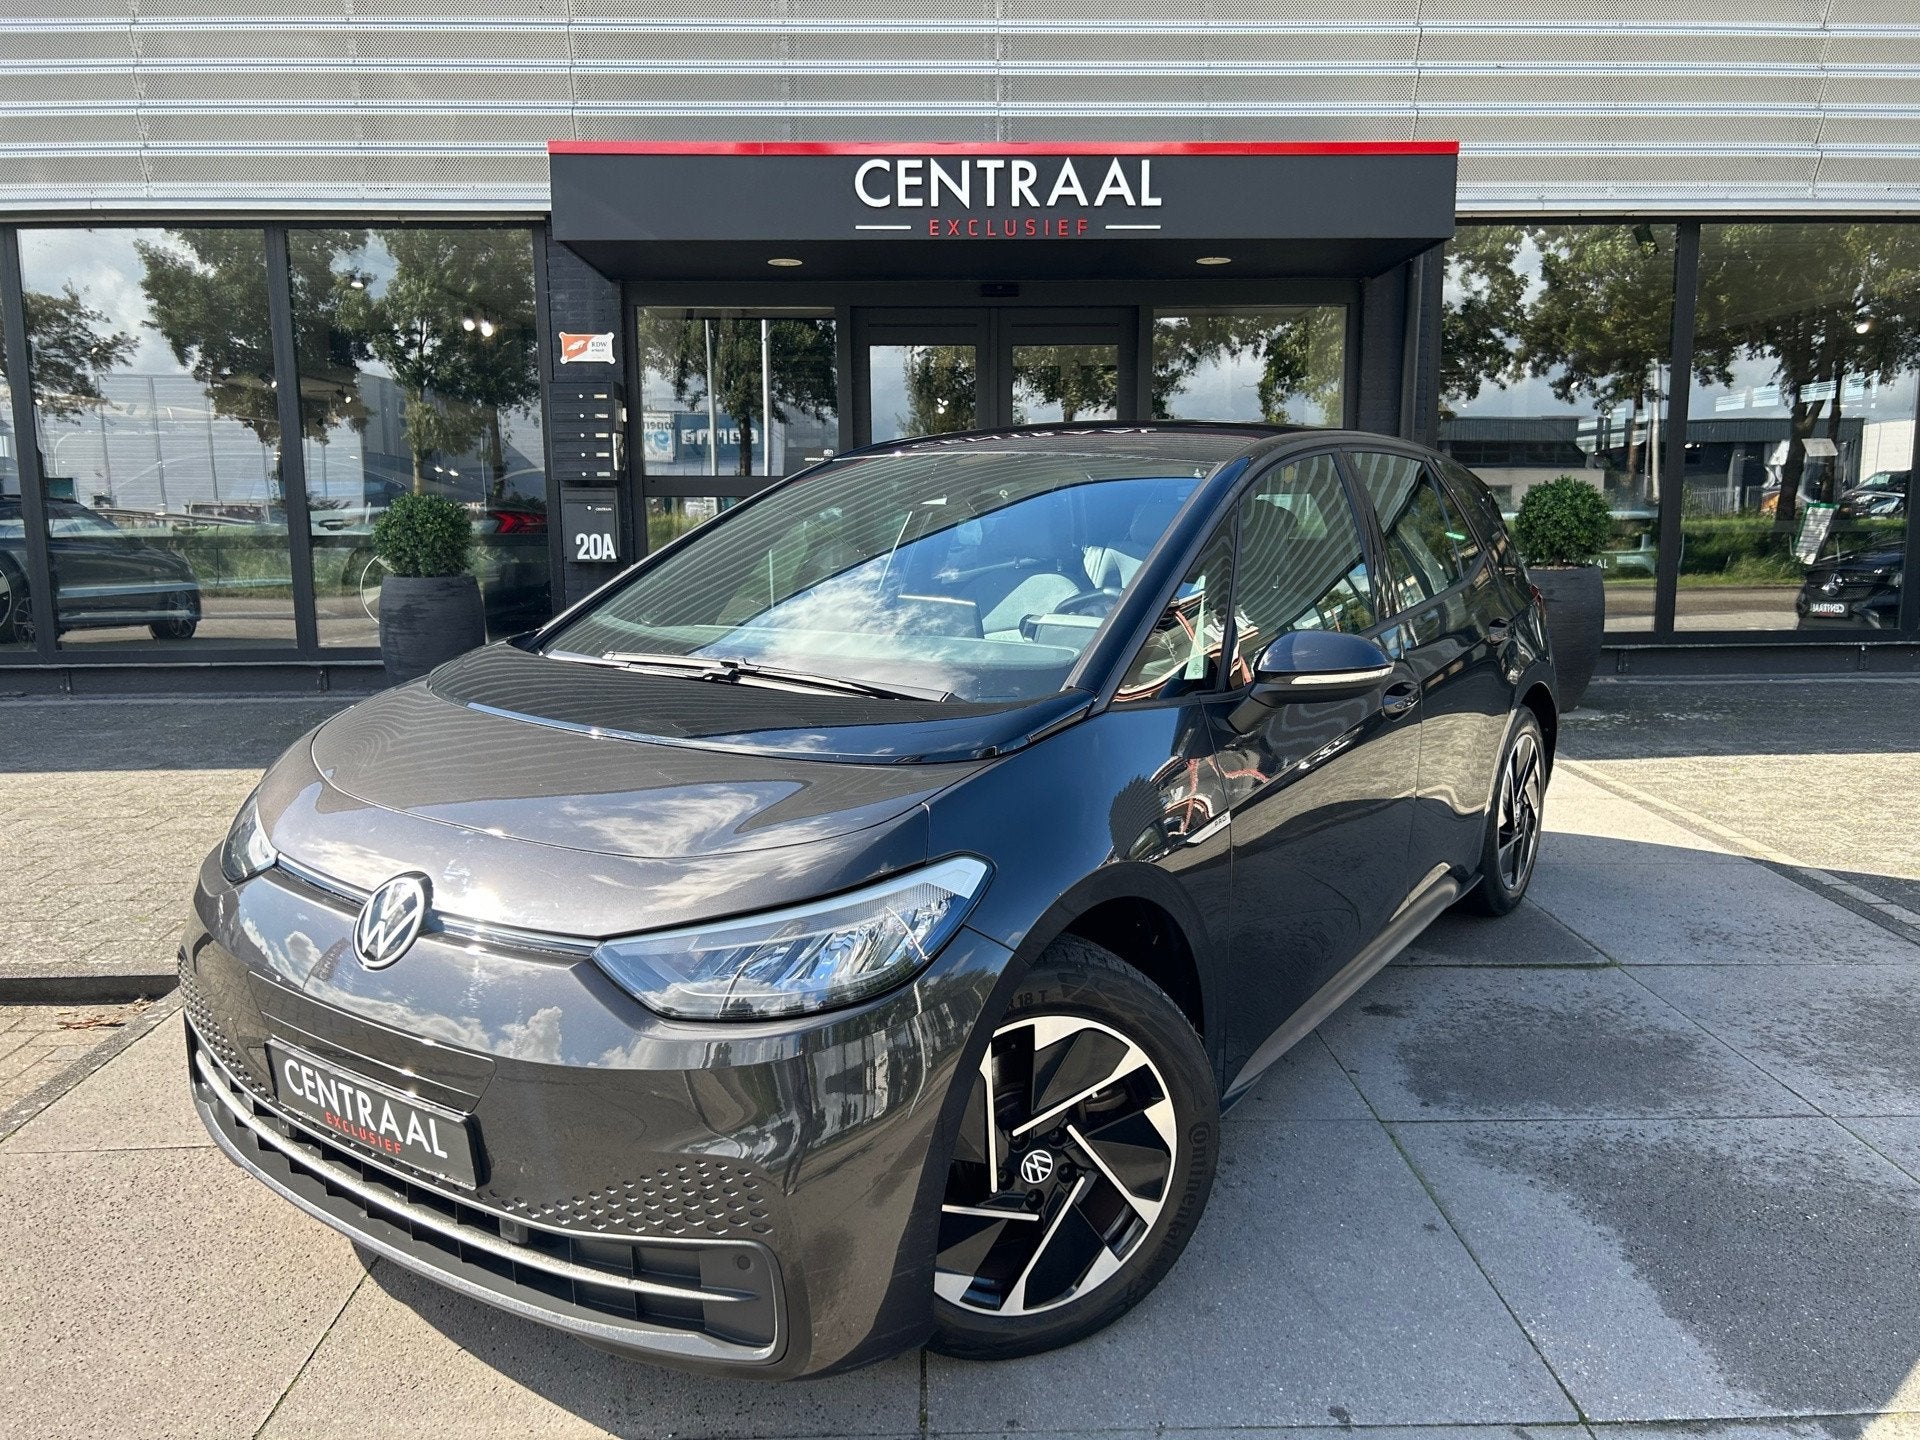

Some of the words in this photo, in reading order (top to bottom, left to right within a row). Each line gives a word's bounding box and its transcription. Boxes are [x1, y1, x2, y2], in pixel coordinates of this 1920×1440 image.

[854, 156, 1163, 209] CENTRAAL
[928, 217, 1089, 237] EXCLUSIEF
[575, 532, 617, 560] 20A
[284, 1058, 448, 1159] CENTRAAL
[325, 1111, 402, 1155] EXCLUSIEF
